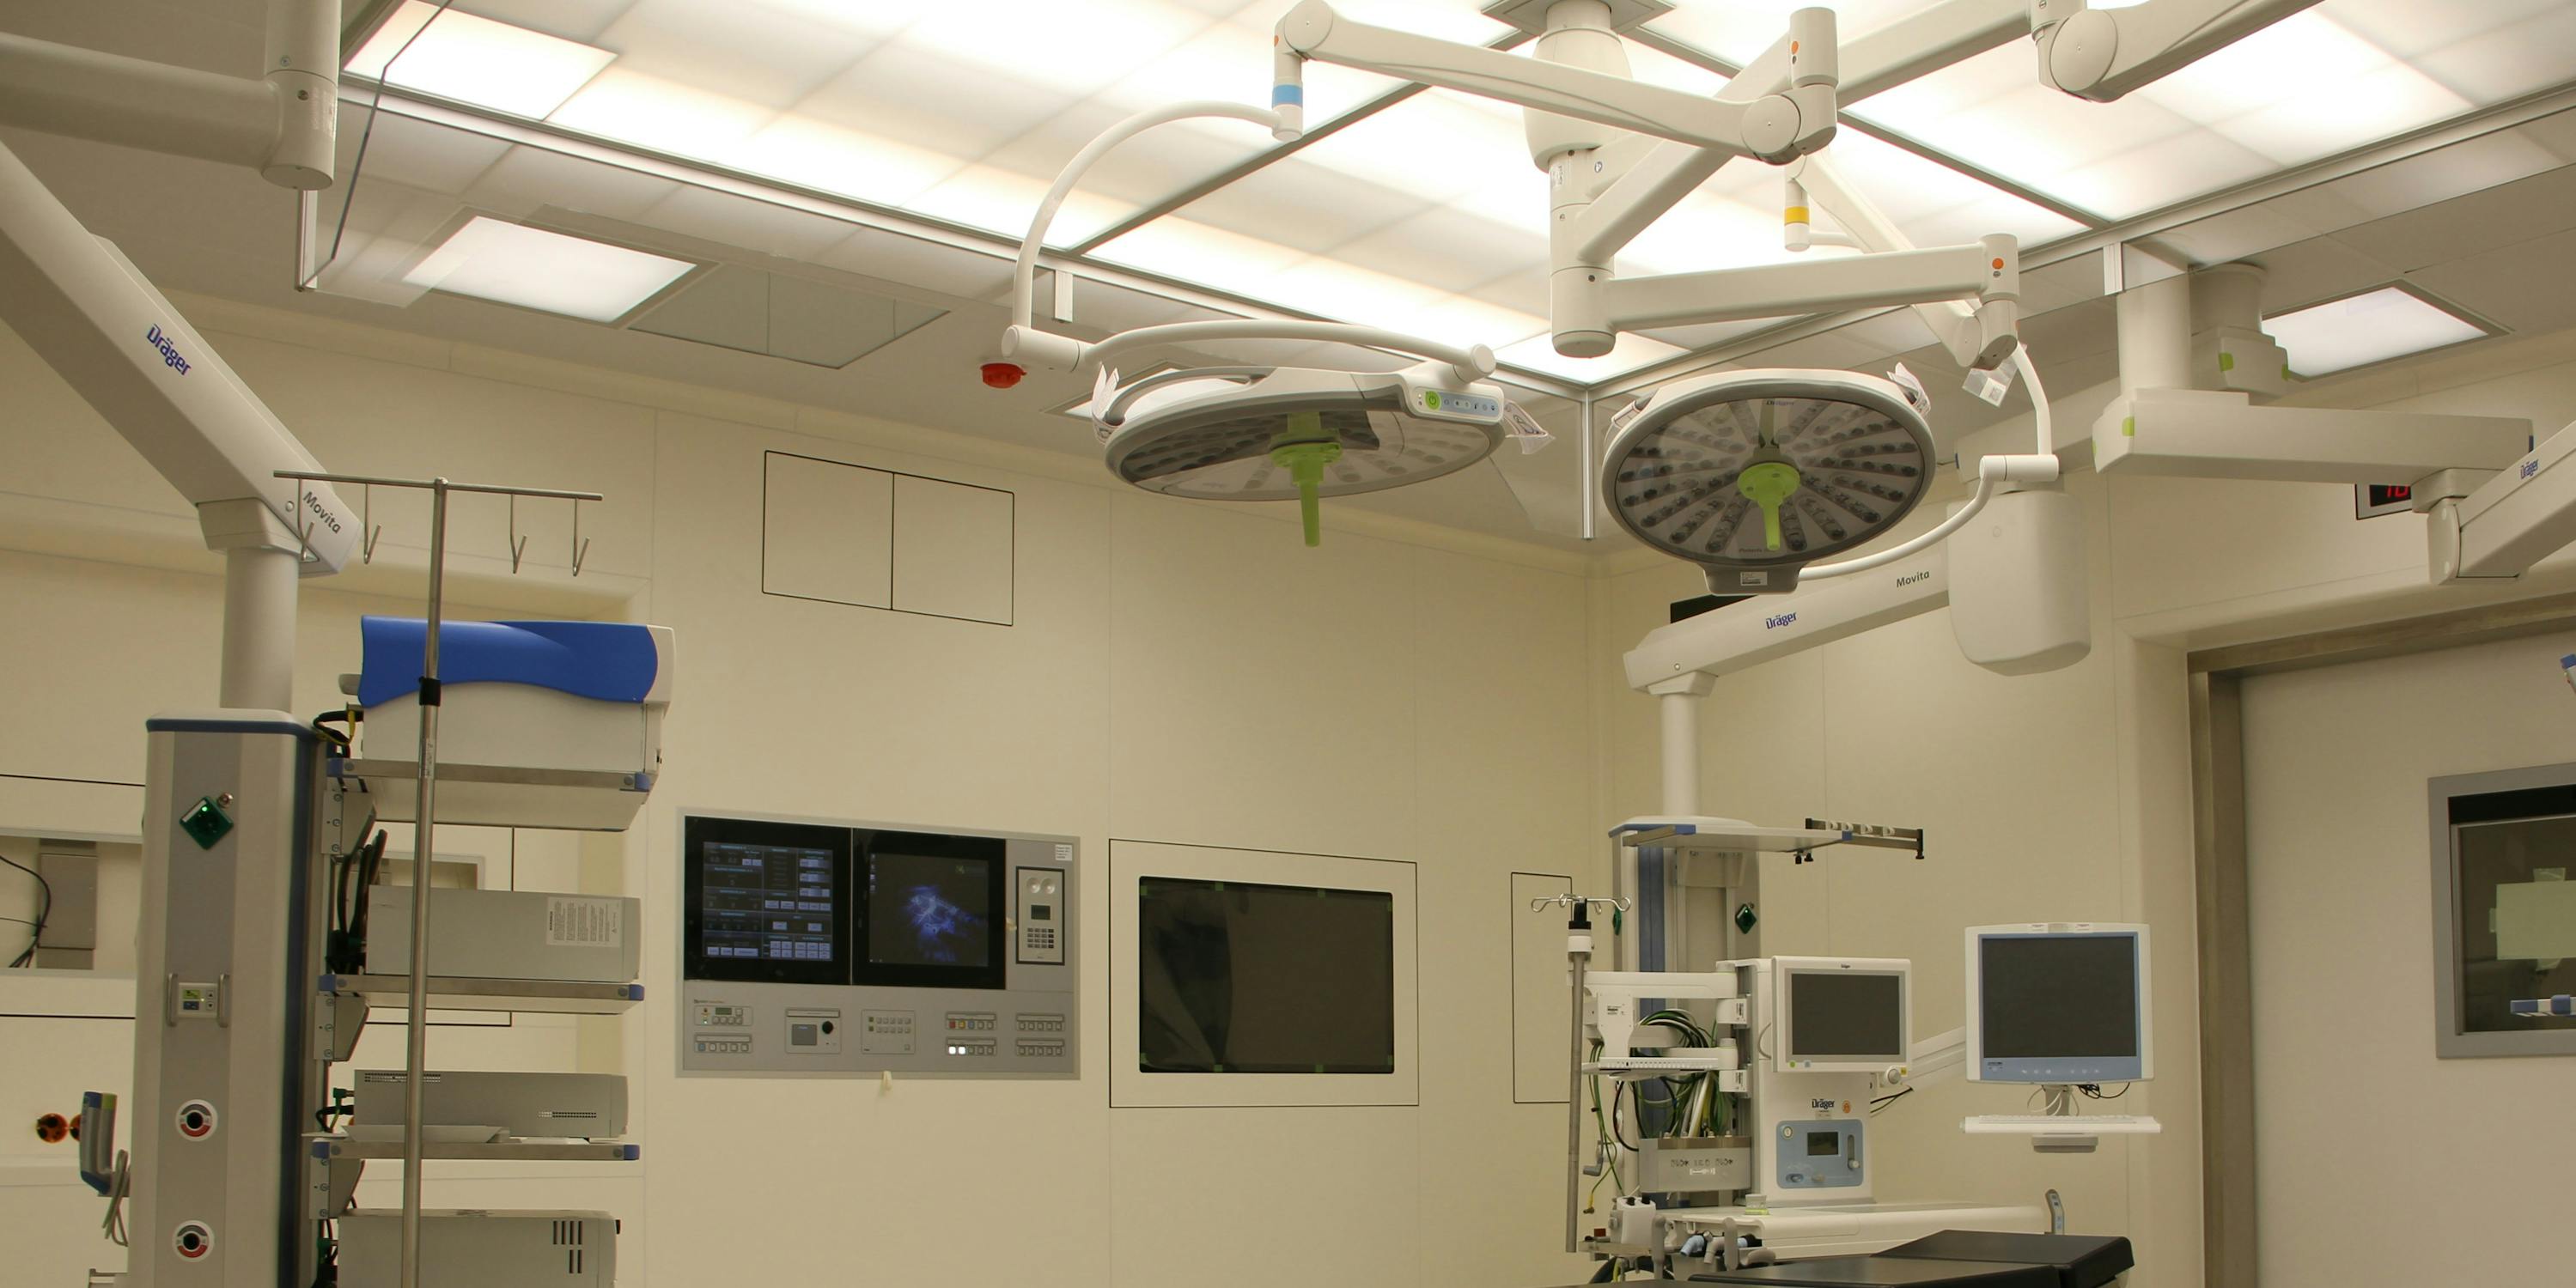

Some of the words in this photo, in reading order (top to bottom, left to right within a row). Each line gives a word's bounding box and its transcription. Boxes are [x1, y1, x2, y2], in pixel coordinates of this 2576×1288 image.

[146, 324, 192, 375] Dräger
[2520, 459, 2539, 479] Dräger
[302, 491, 342, 534] Movita
[1896, 570, 1930, 588] Movita
[1766, 611, 1797, 630] Dräger
[1812, 1098, 1835, 1109] Dräger
